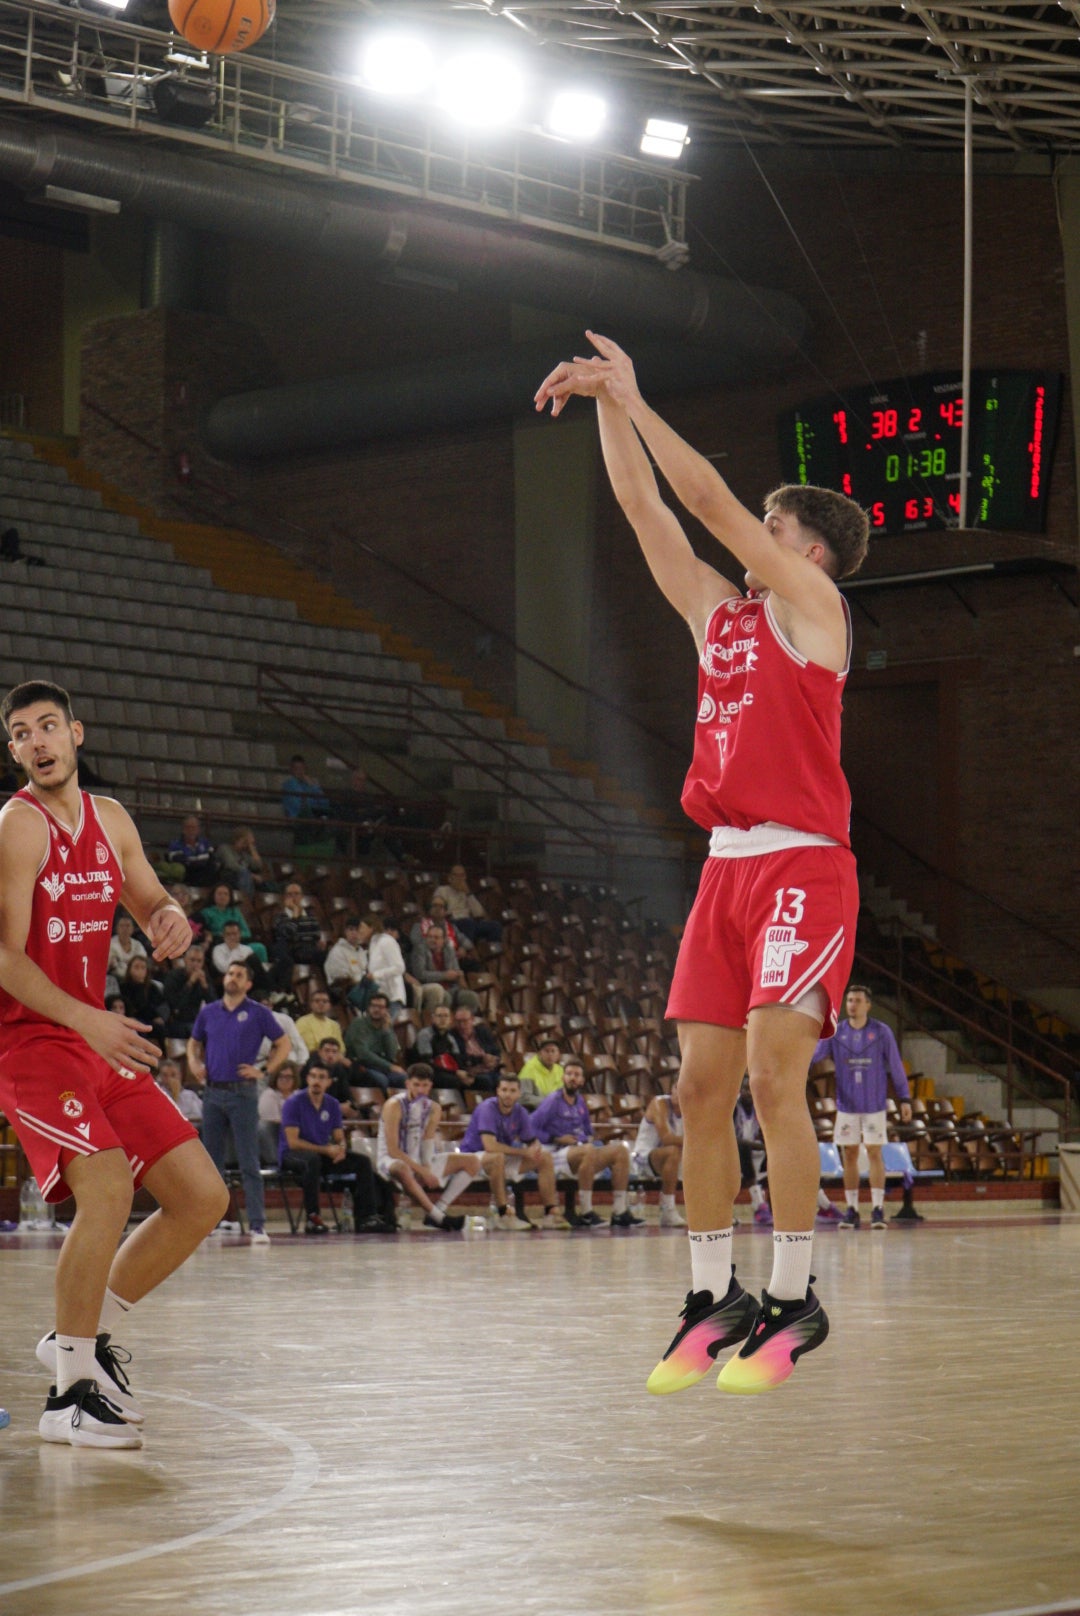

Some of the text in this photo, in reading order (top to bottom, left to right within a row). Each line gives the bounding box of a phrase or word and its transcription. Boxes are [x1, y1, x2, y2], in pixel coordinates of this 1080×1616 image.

[872, 409, 898, 439] 38
[908, 408, 922, 431] 2
[886, 448, 946, 482] 01:38
[872, 502, 885, 526] 5
[772, 887, 807, 924] 13
[768, 929, 792, 943] BUN
[762, 970, 785, 984] HAM
